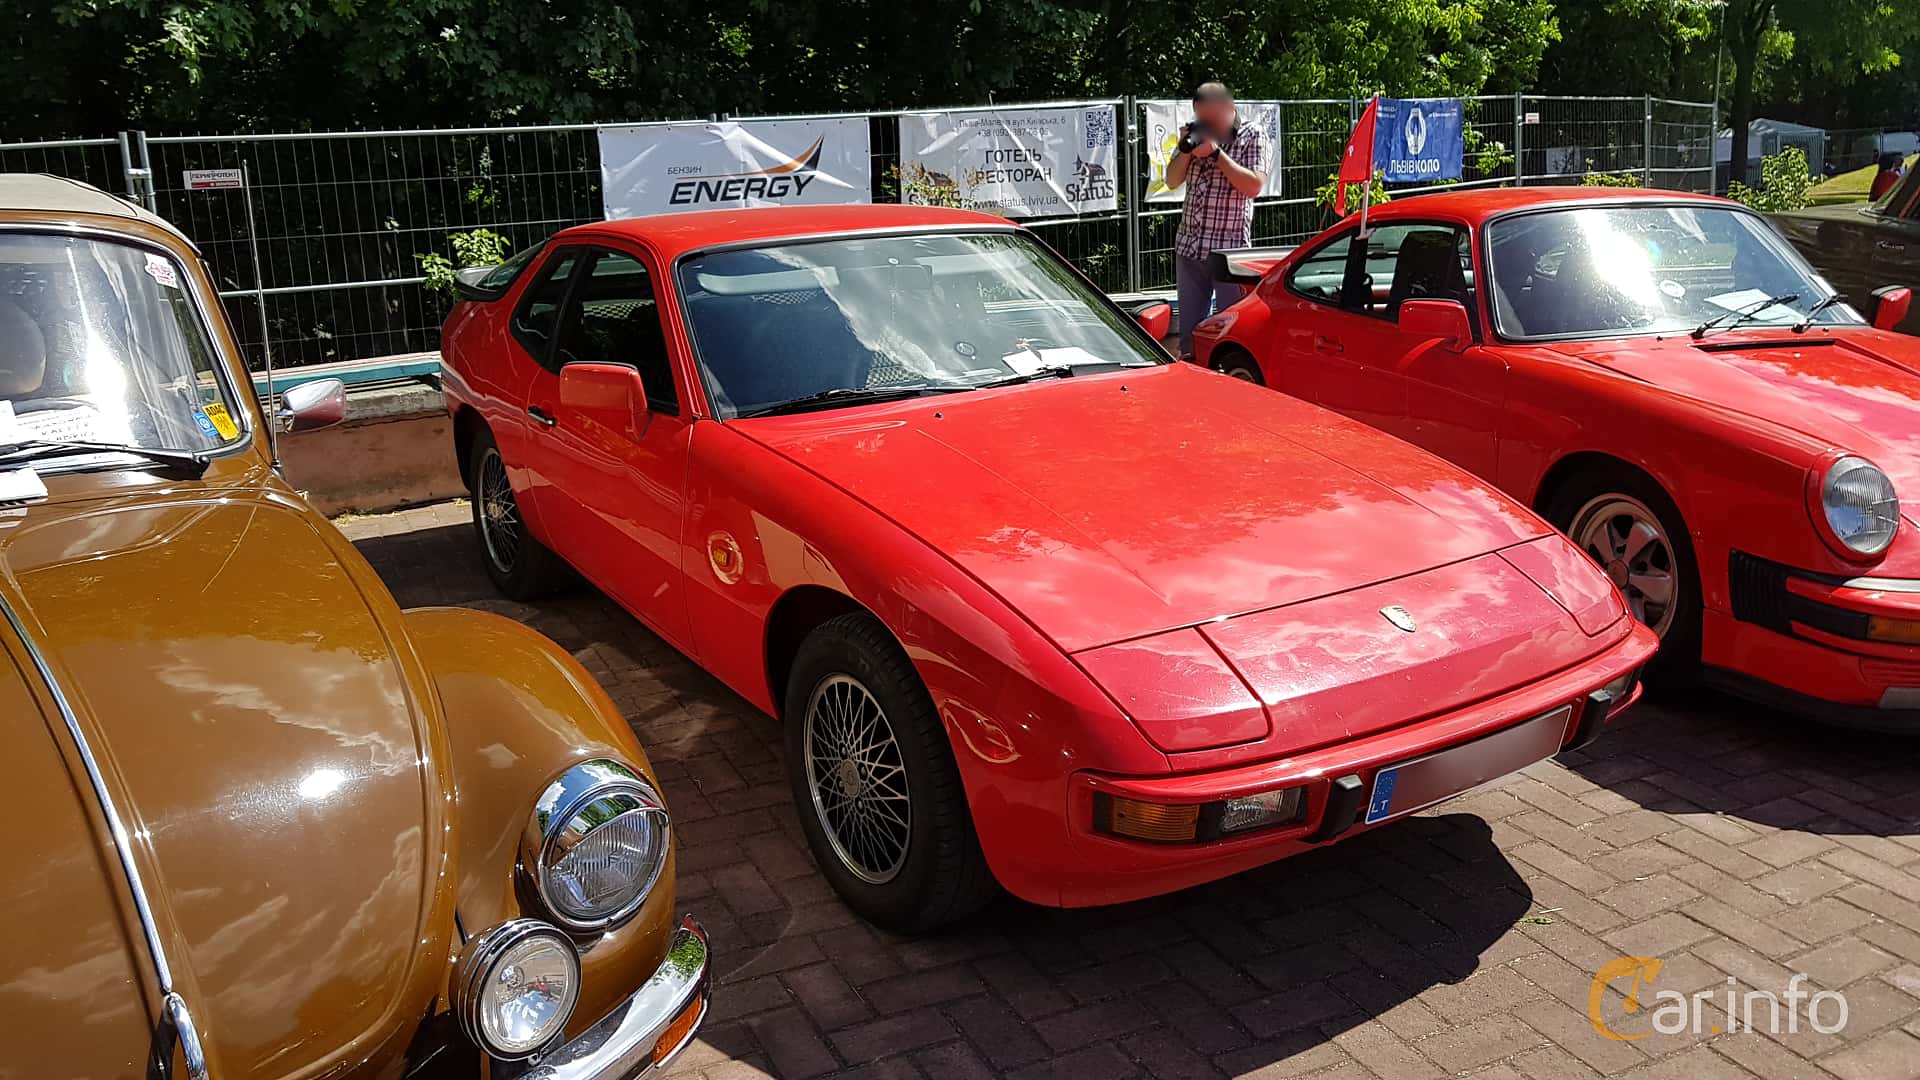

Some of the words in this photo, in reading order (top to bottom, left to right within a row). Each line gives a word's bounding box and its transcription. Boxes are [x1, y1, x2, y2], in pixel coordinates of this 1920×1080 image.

[985, 149, 1042, 165] ГОТЕЛЬ
[667, 165, 702, 175] БЕНЗИН
[976, 167, 1052, 185] РЕСТОРАН
[669, 175, 816, 205] ENERGY
[1371, 799, 1389, 814] LT
